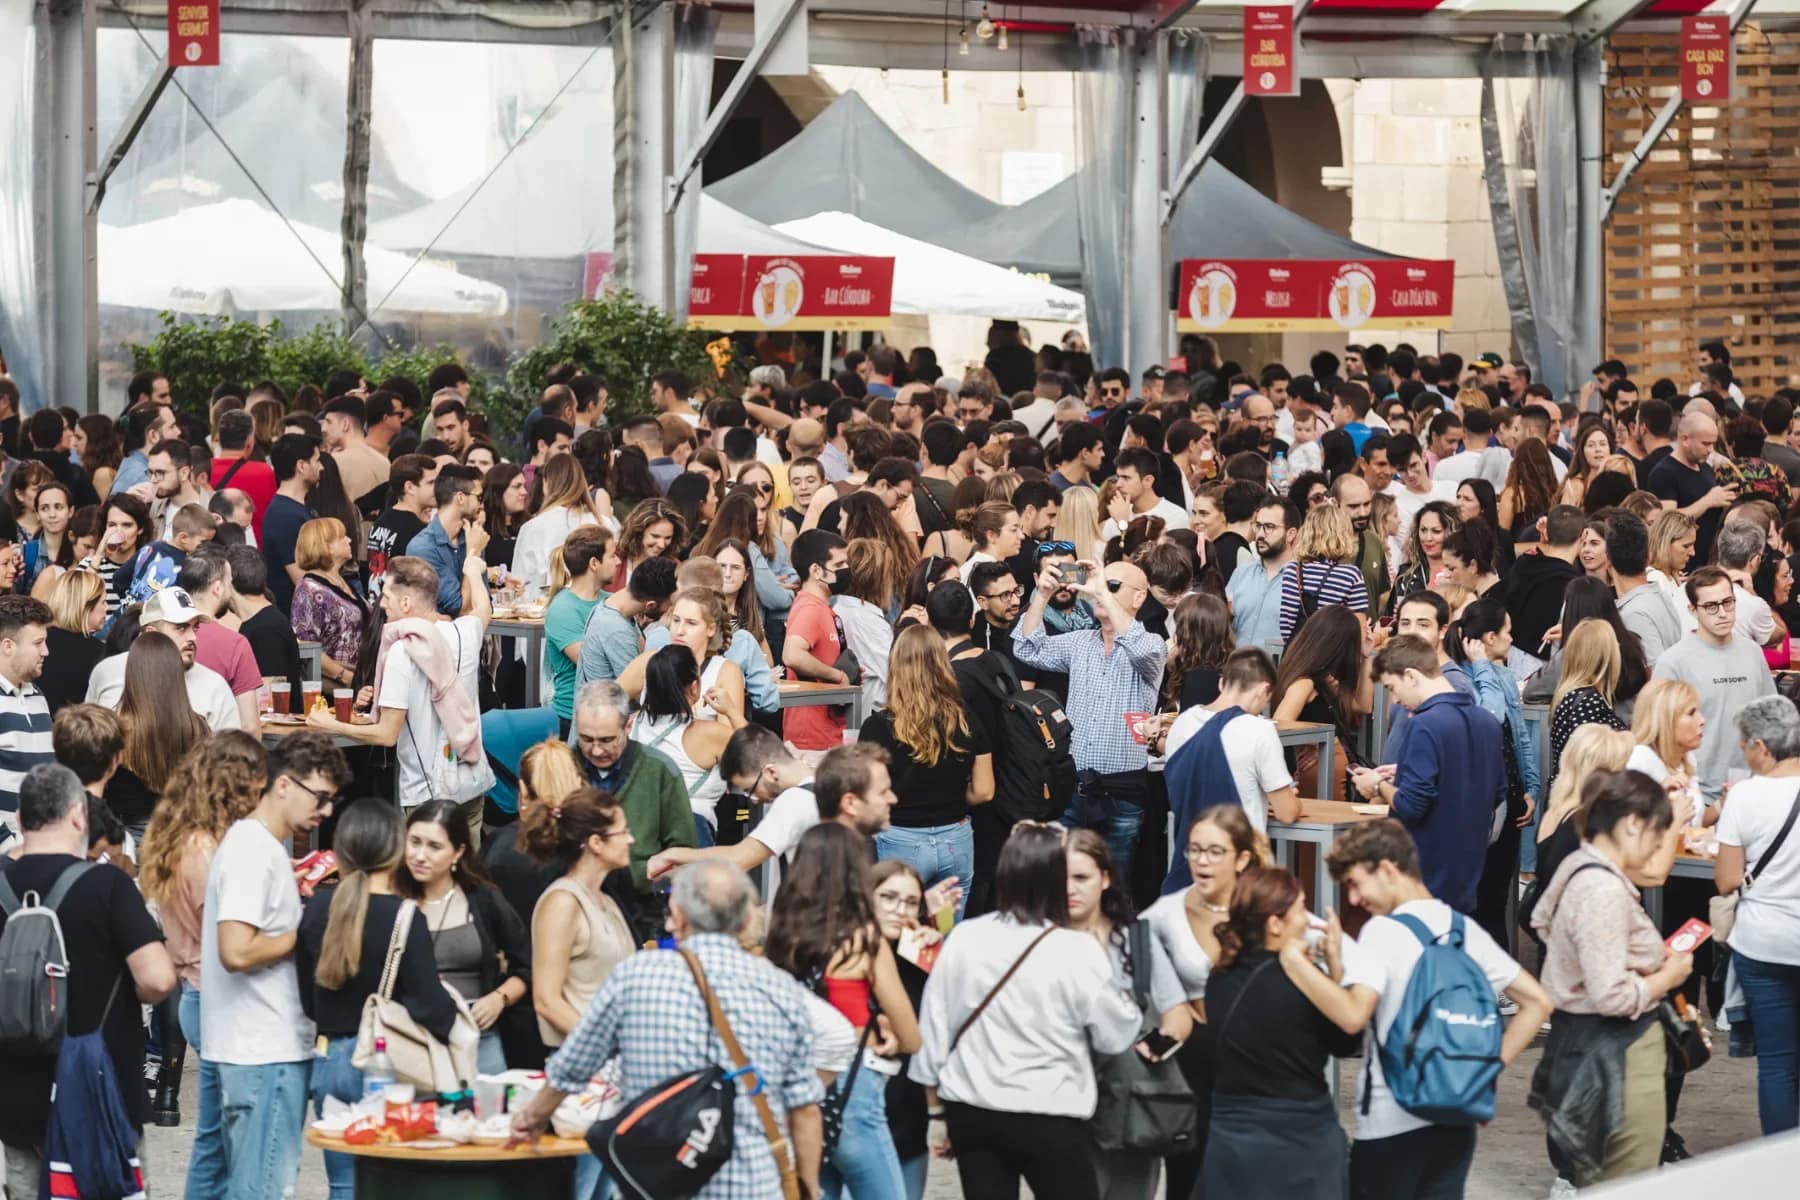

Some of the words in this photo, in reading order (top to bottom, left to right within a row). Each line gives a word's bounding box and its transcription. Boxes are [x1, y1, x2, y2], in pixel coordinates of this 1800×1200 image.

[1260, 39, 1276, 53] BAR
[1686, 49, 1705, 62] CASA
[1696, 63, 1714, 76] BCN
[676, 1108, 721, 1169] FILA
